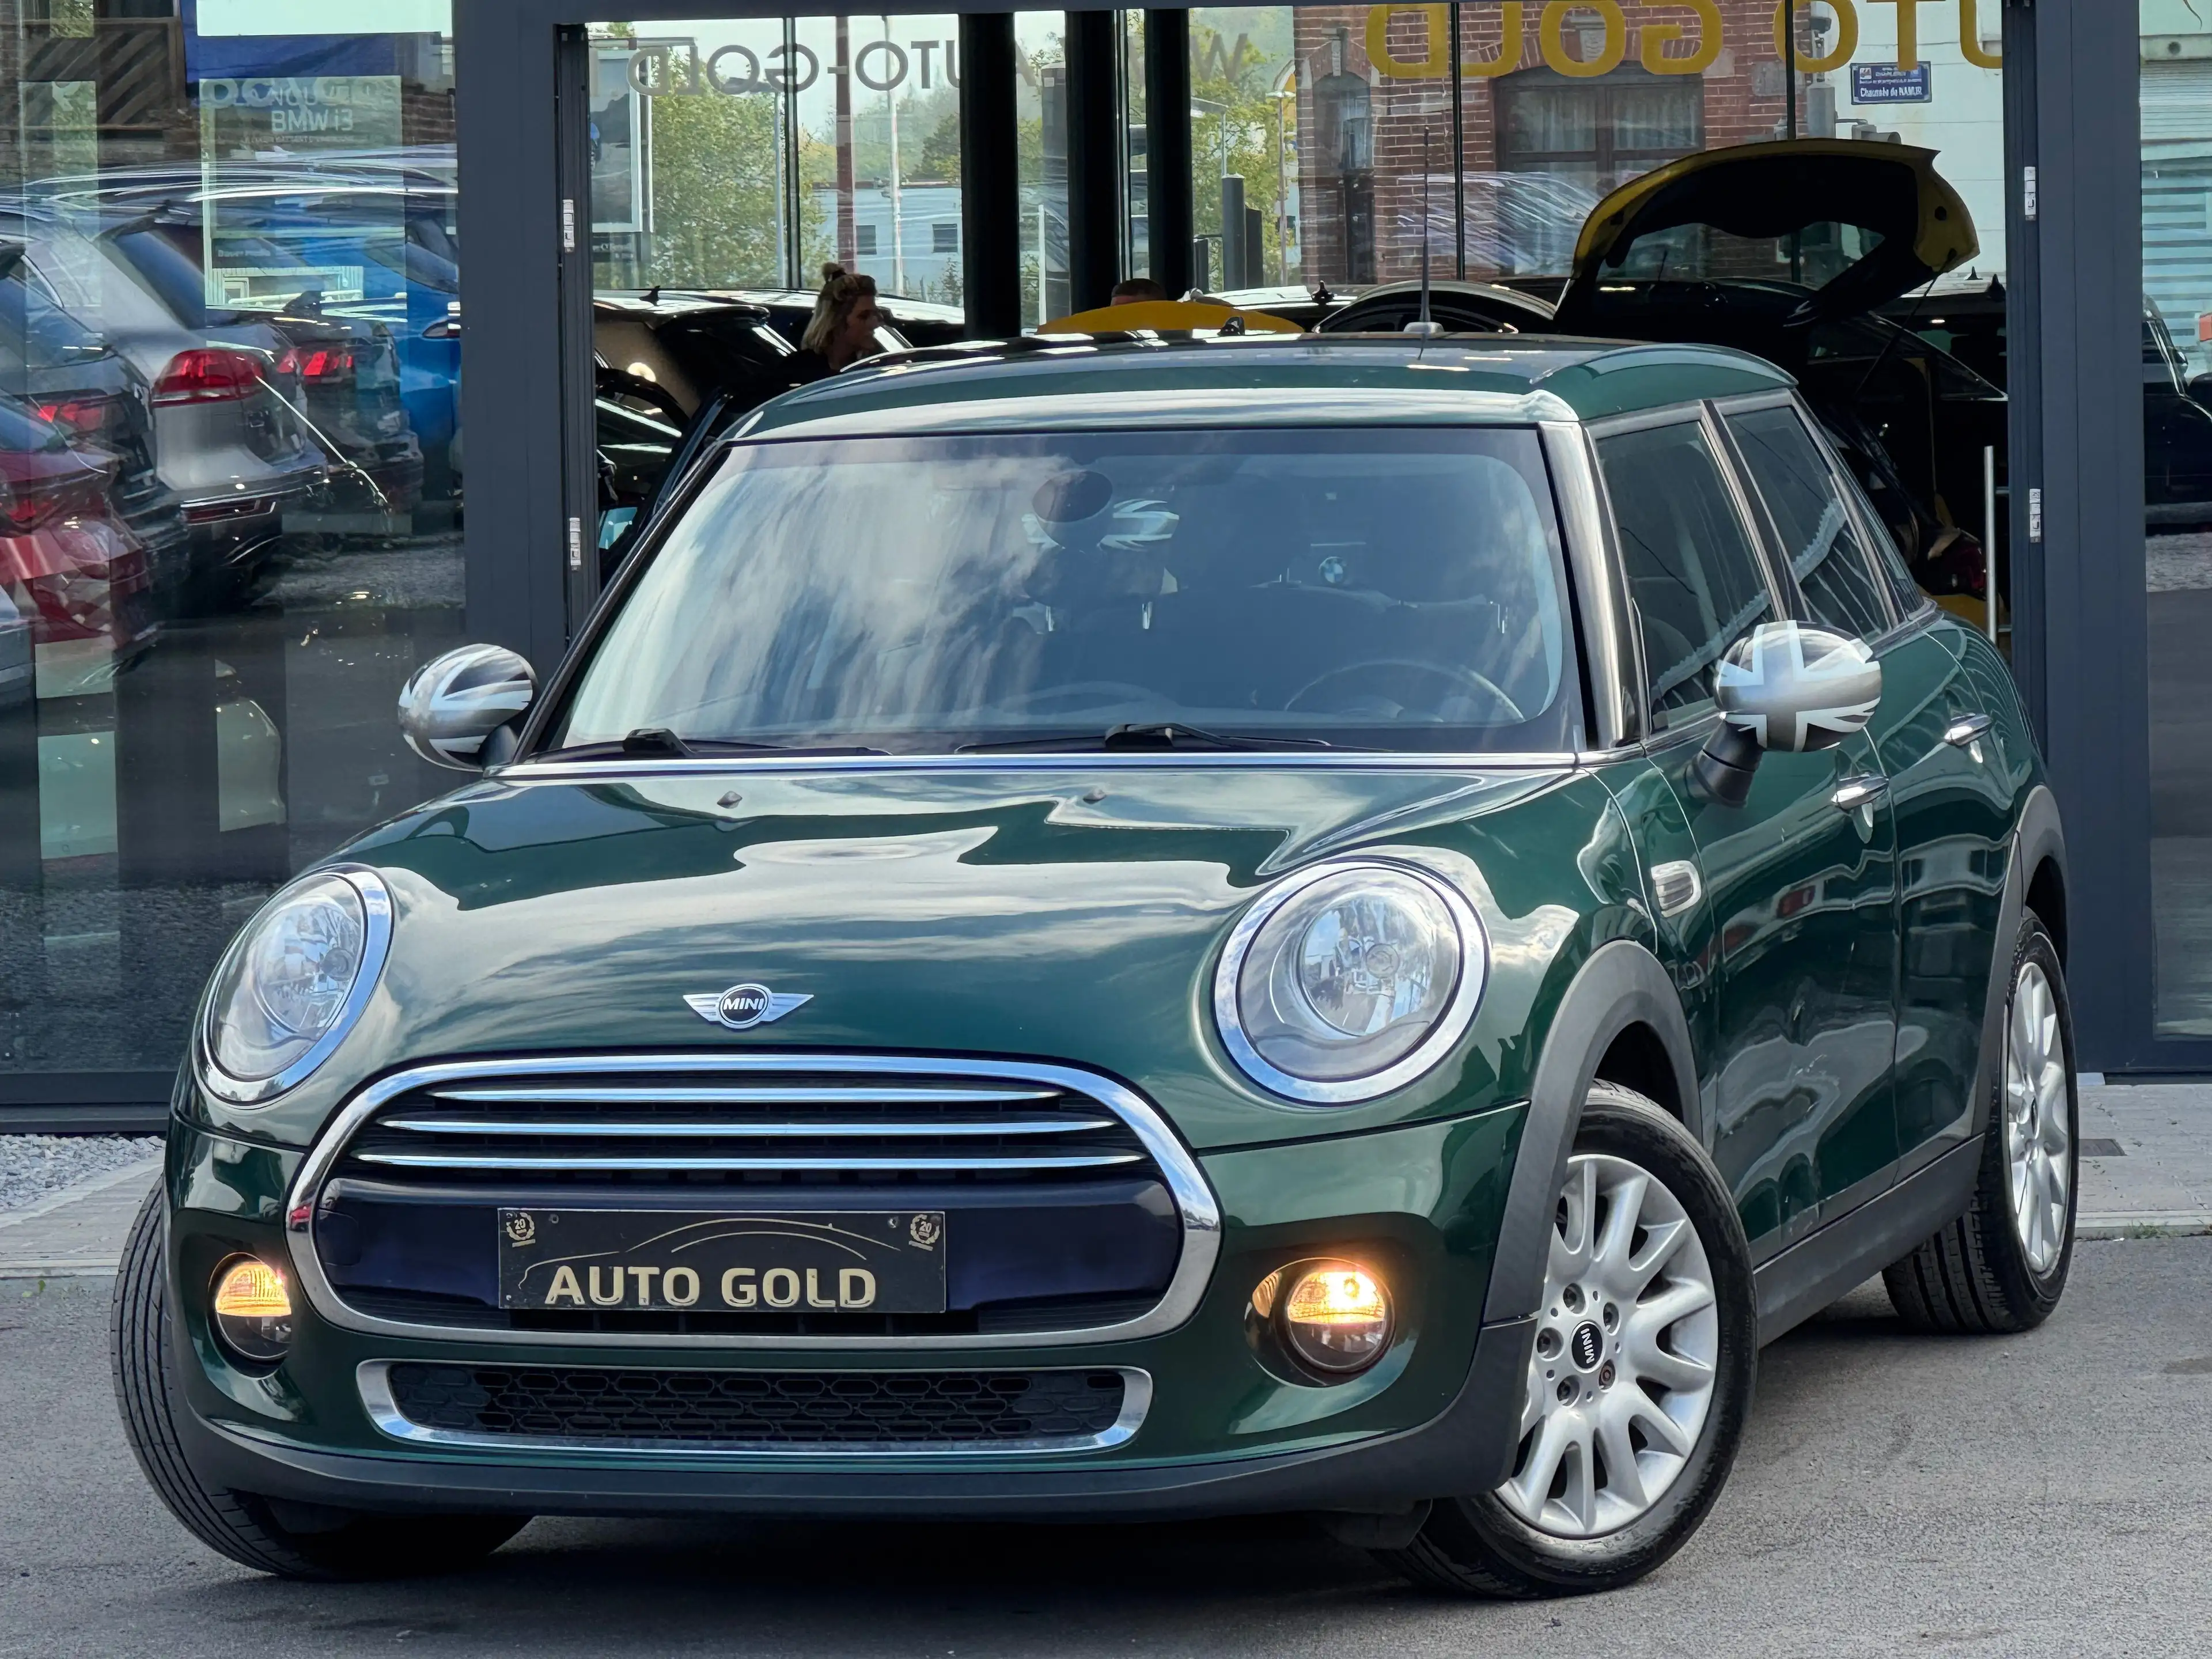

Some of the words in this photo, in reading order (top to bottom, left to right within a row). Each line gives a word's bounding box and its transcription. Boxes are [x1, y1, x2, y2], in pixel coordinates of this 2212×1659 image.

[272, 109, 328, 132] BMW
[723, 998, 764, 1010] MINI
[514, 1218, 526, 1230] 20
[919, 1221, 932, 1233] 20
[544, 1265, 699, 1306] AUTO
[721, 1267, 877, 1309] GOLD
[1580, 1328, 1595, 1364] MINI
